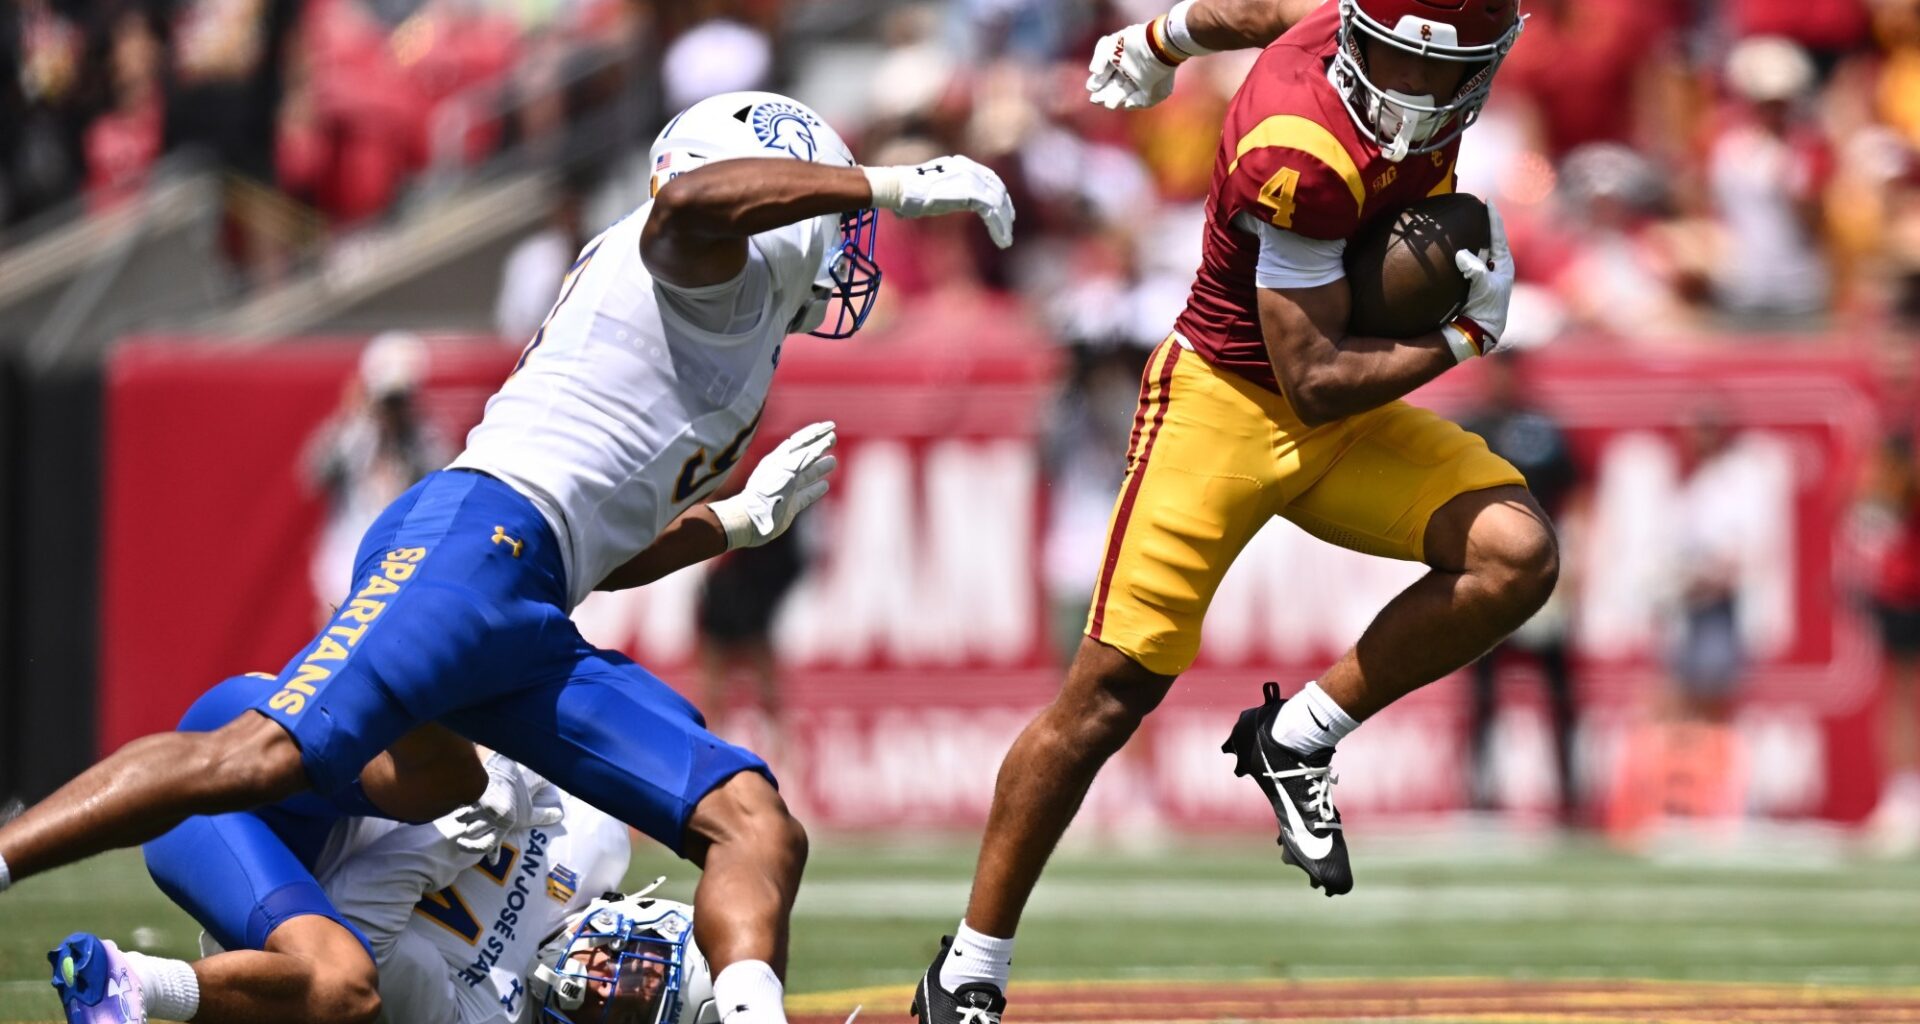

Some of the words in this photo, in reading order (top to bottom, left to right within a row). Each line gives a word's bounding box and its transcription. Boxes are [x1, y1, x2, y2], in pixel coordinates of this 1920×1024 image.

[1258, 166, 1301, 229] 4
[269, 547, 426, 714] SPARTANS
[521, 828, 548, 878] SAN
[493, 875, 530, 941] JOSÉ
[458, 936, 504, 988] STATE
